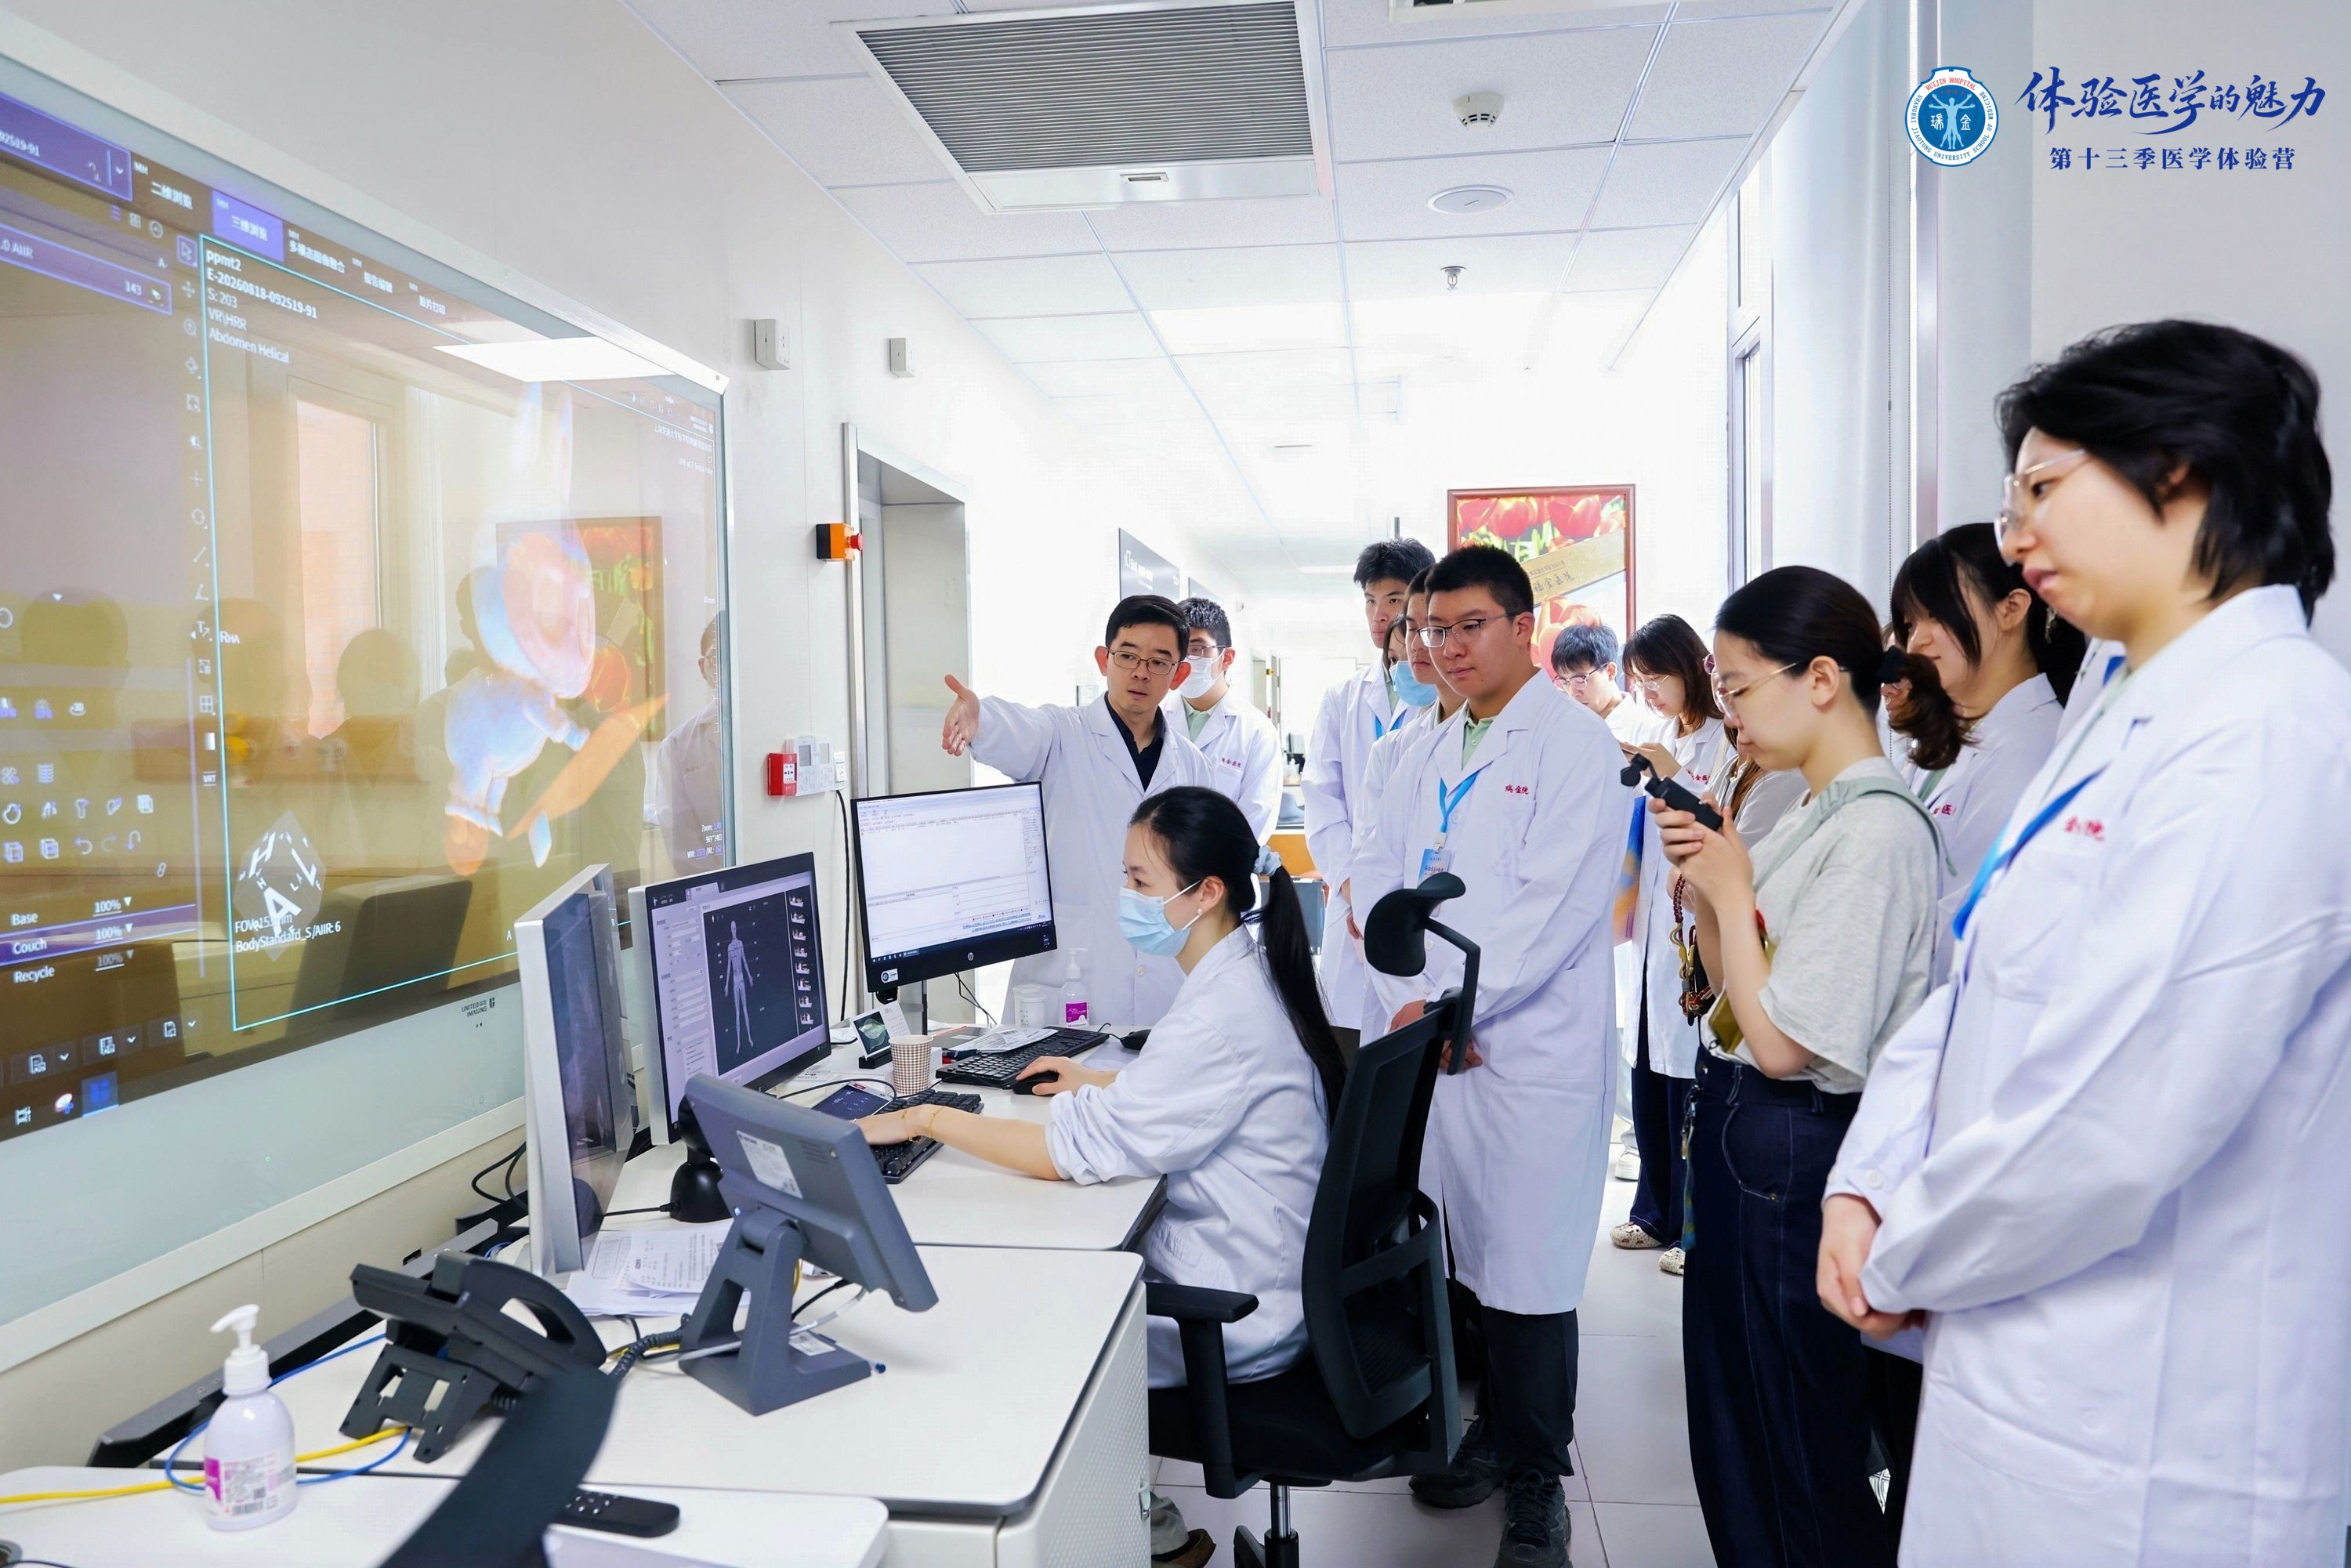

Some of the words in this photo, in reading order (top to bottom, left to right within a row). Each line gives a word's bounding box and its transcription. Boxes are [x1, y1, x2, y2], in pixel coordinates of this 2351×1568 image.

[205, 249, 242, 272] ppmt2
[206, 268, 318, 319] E-20260818-092519-91
[220, 292, 238, 309] 203
[208, 328, 257, 353] Abdomen
[258, 343, 290, 364] Helical
[10, 913, 38, 926] Base
[94, 899, 121, 914] 100%
[13, 938, 48, 954] Couch
[95, 925, 123, 940] 100%
[13, 965, 56, 984] Recycle
[97, 953, 124, 967] 100%
[466, 1005, 487, 1018] IMAGING
